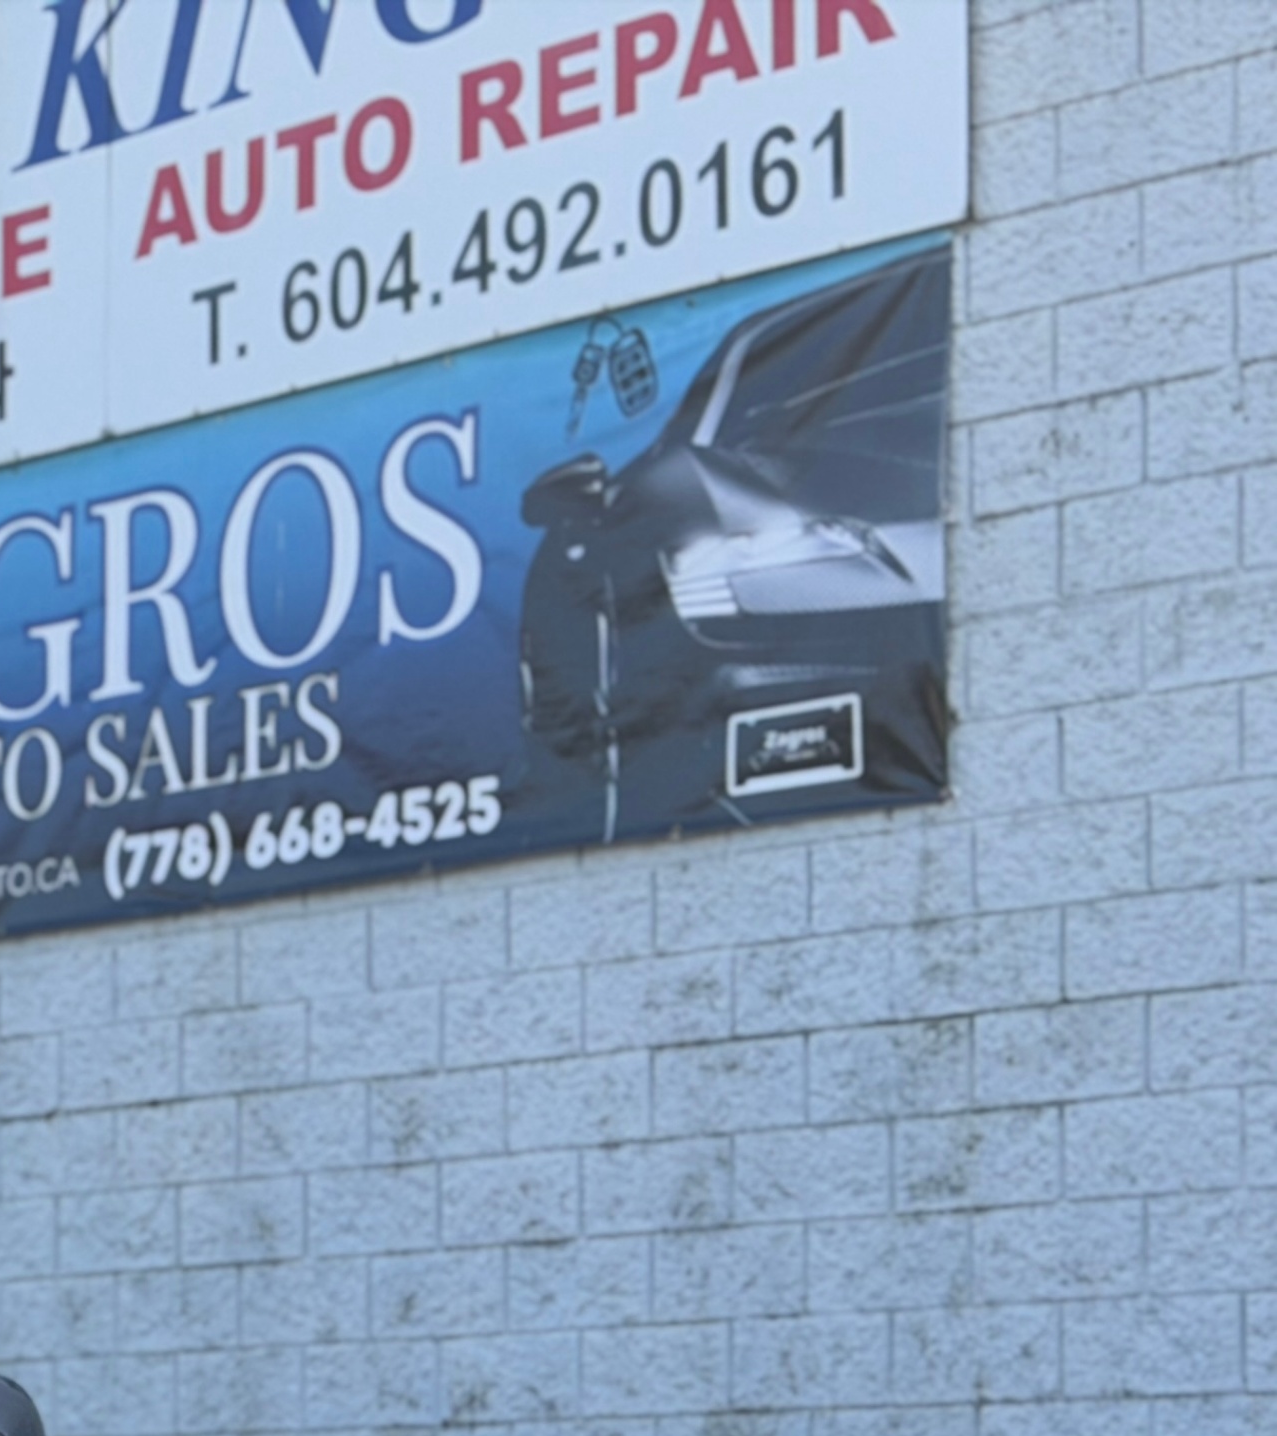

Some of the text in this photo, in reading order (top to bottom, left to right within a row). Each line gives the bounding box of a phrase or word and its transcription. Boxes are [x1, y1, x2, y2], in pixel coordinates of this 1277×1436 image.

[10, 0, 486, 173] KIN
[133, 0, 896, 260] AUTO REPAIR
[192, 108, 845, 367] T. 604.492.0161
[83, 672, 343, 809] SALES
[103, 775, 503, 901] (778) 668-4525
